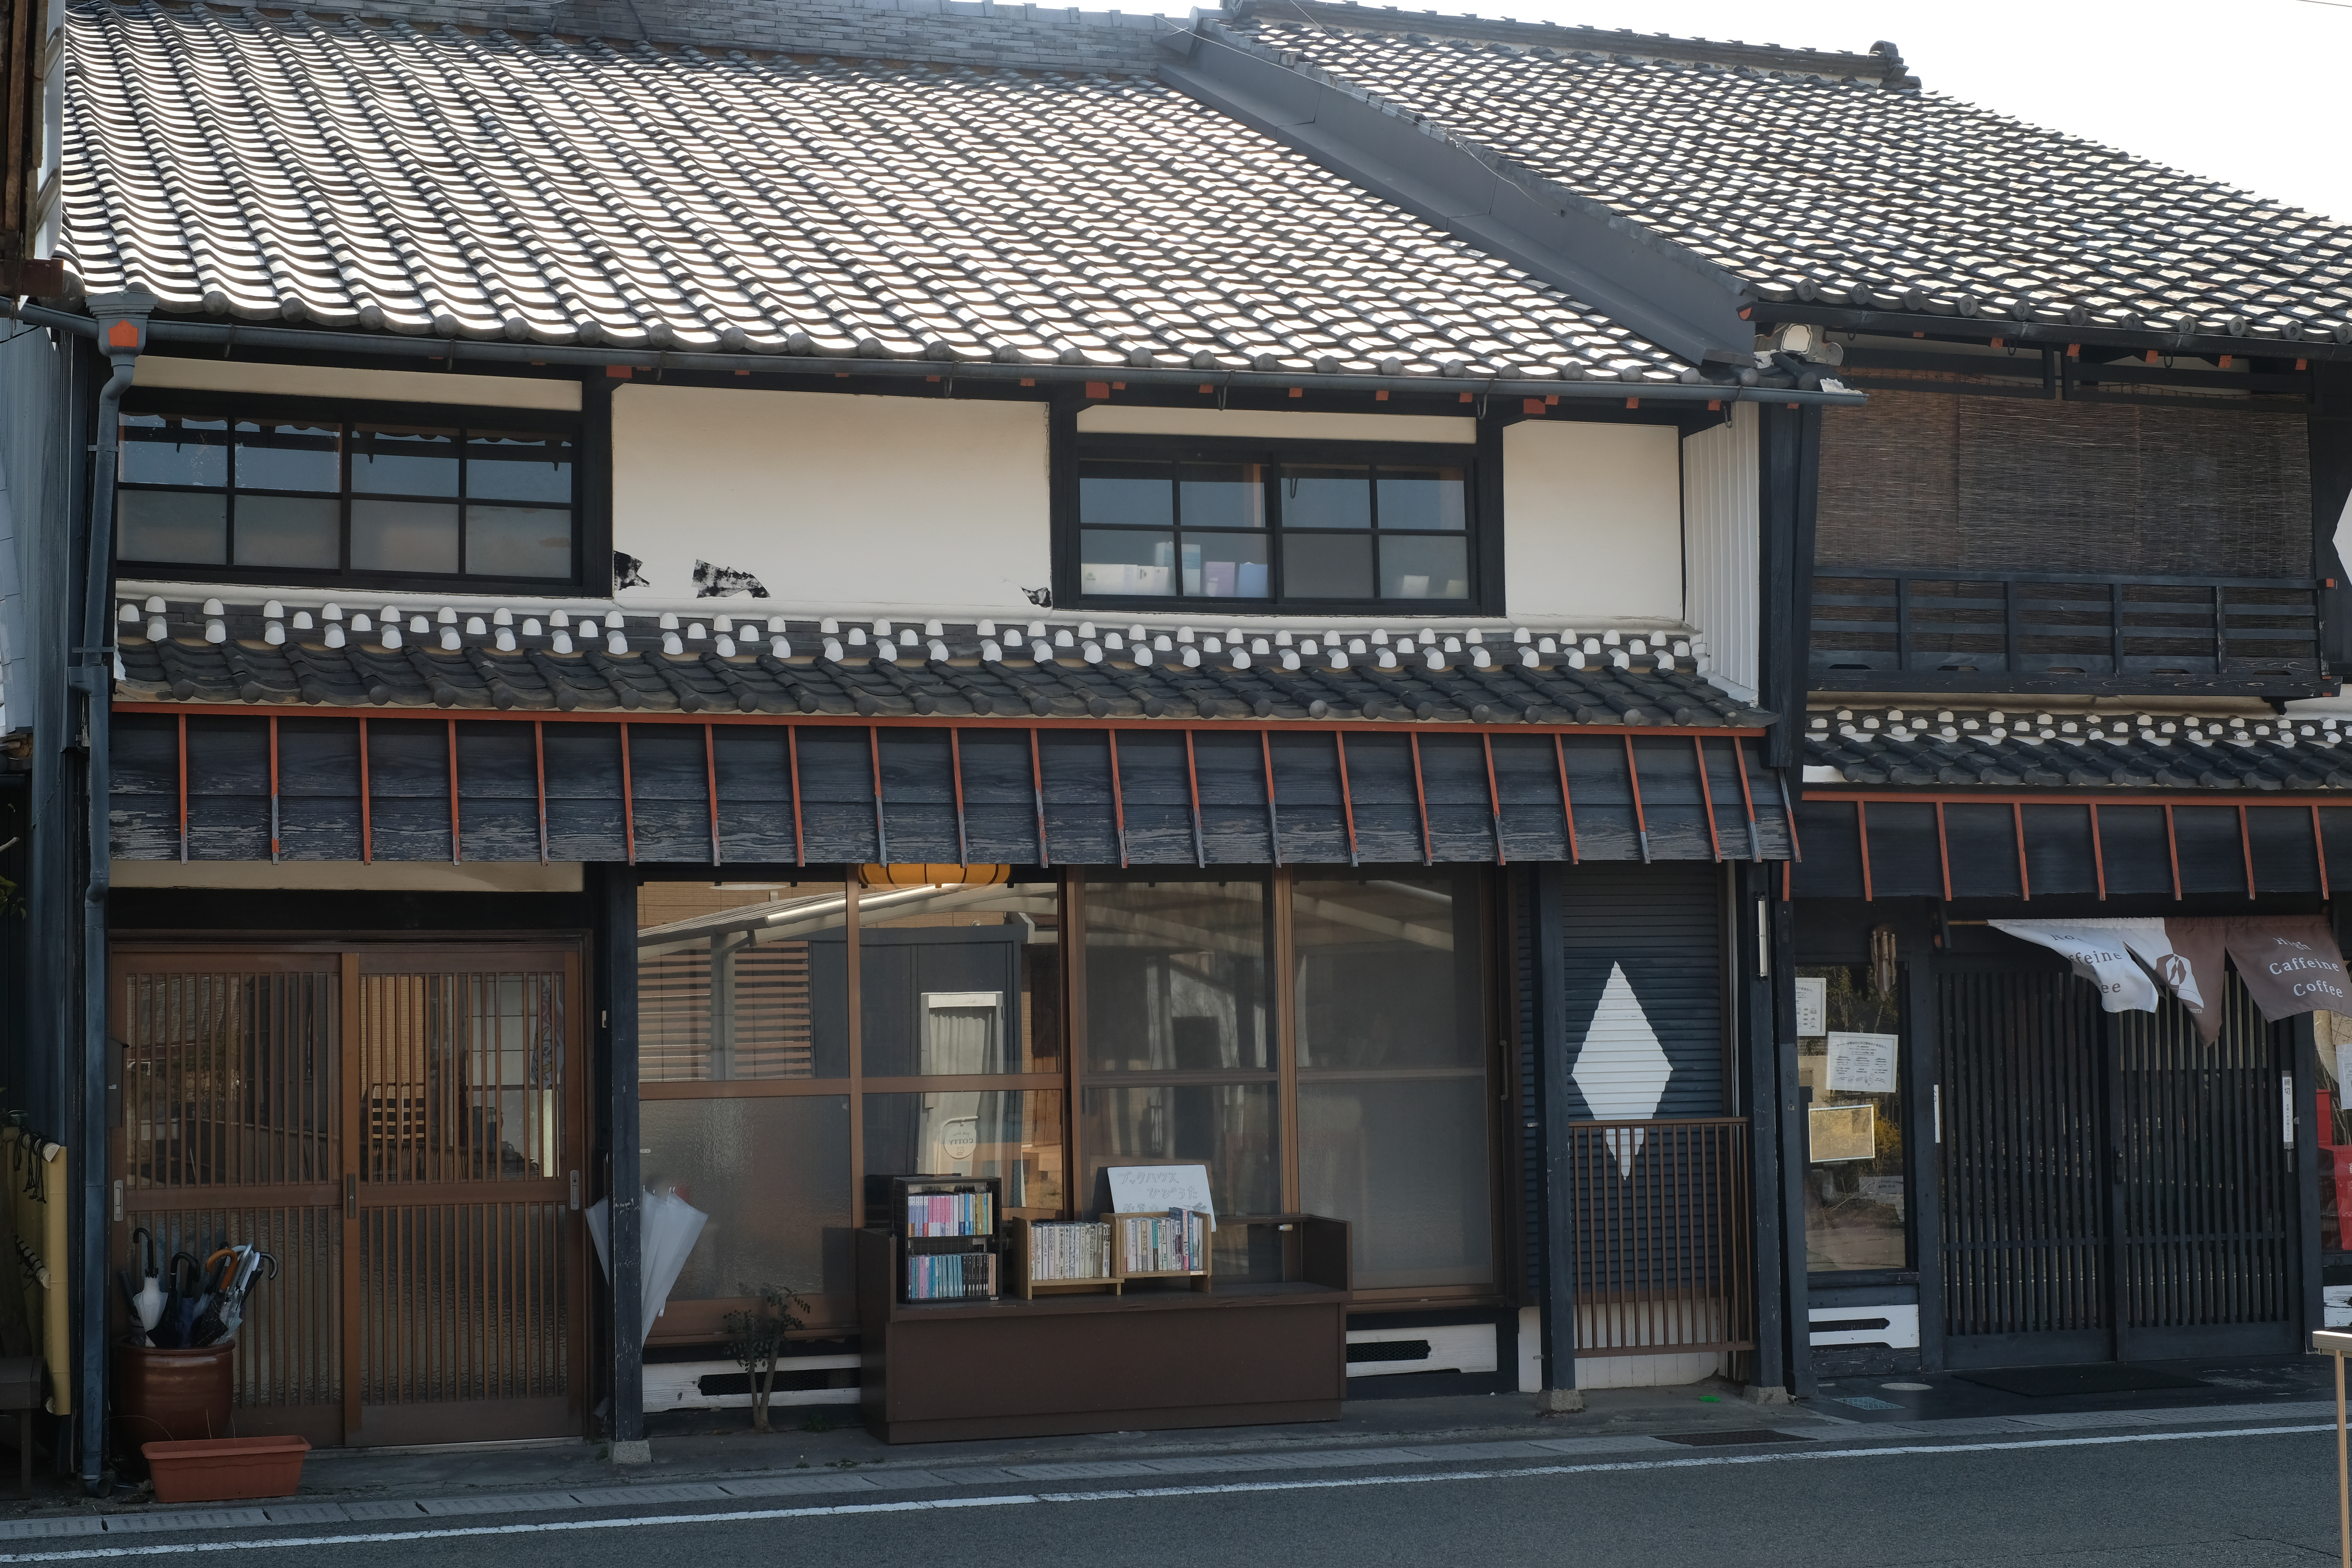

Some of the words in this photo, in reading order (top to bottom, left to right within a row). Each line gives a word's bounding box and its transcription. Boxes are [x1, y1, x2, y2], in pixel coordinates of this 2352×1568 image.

[2272, 937, 2312, 950] High
[2068, 951, 2122, 965] ffeine
[2269, 957, 2339, 975] Caffeine
[2293, 980, 2343, 998] Coffee
[1118, 1171, 1179, 1184] ブックハウス
[1147, 1186, 1198, 1200] ひびうた
